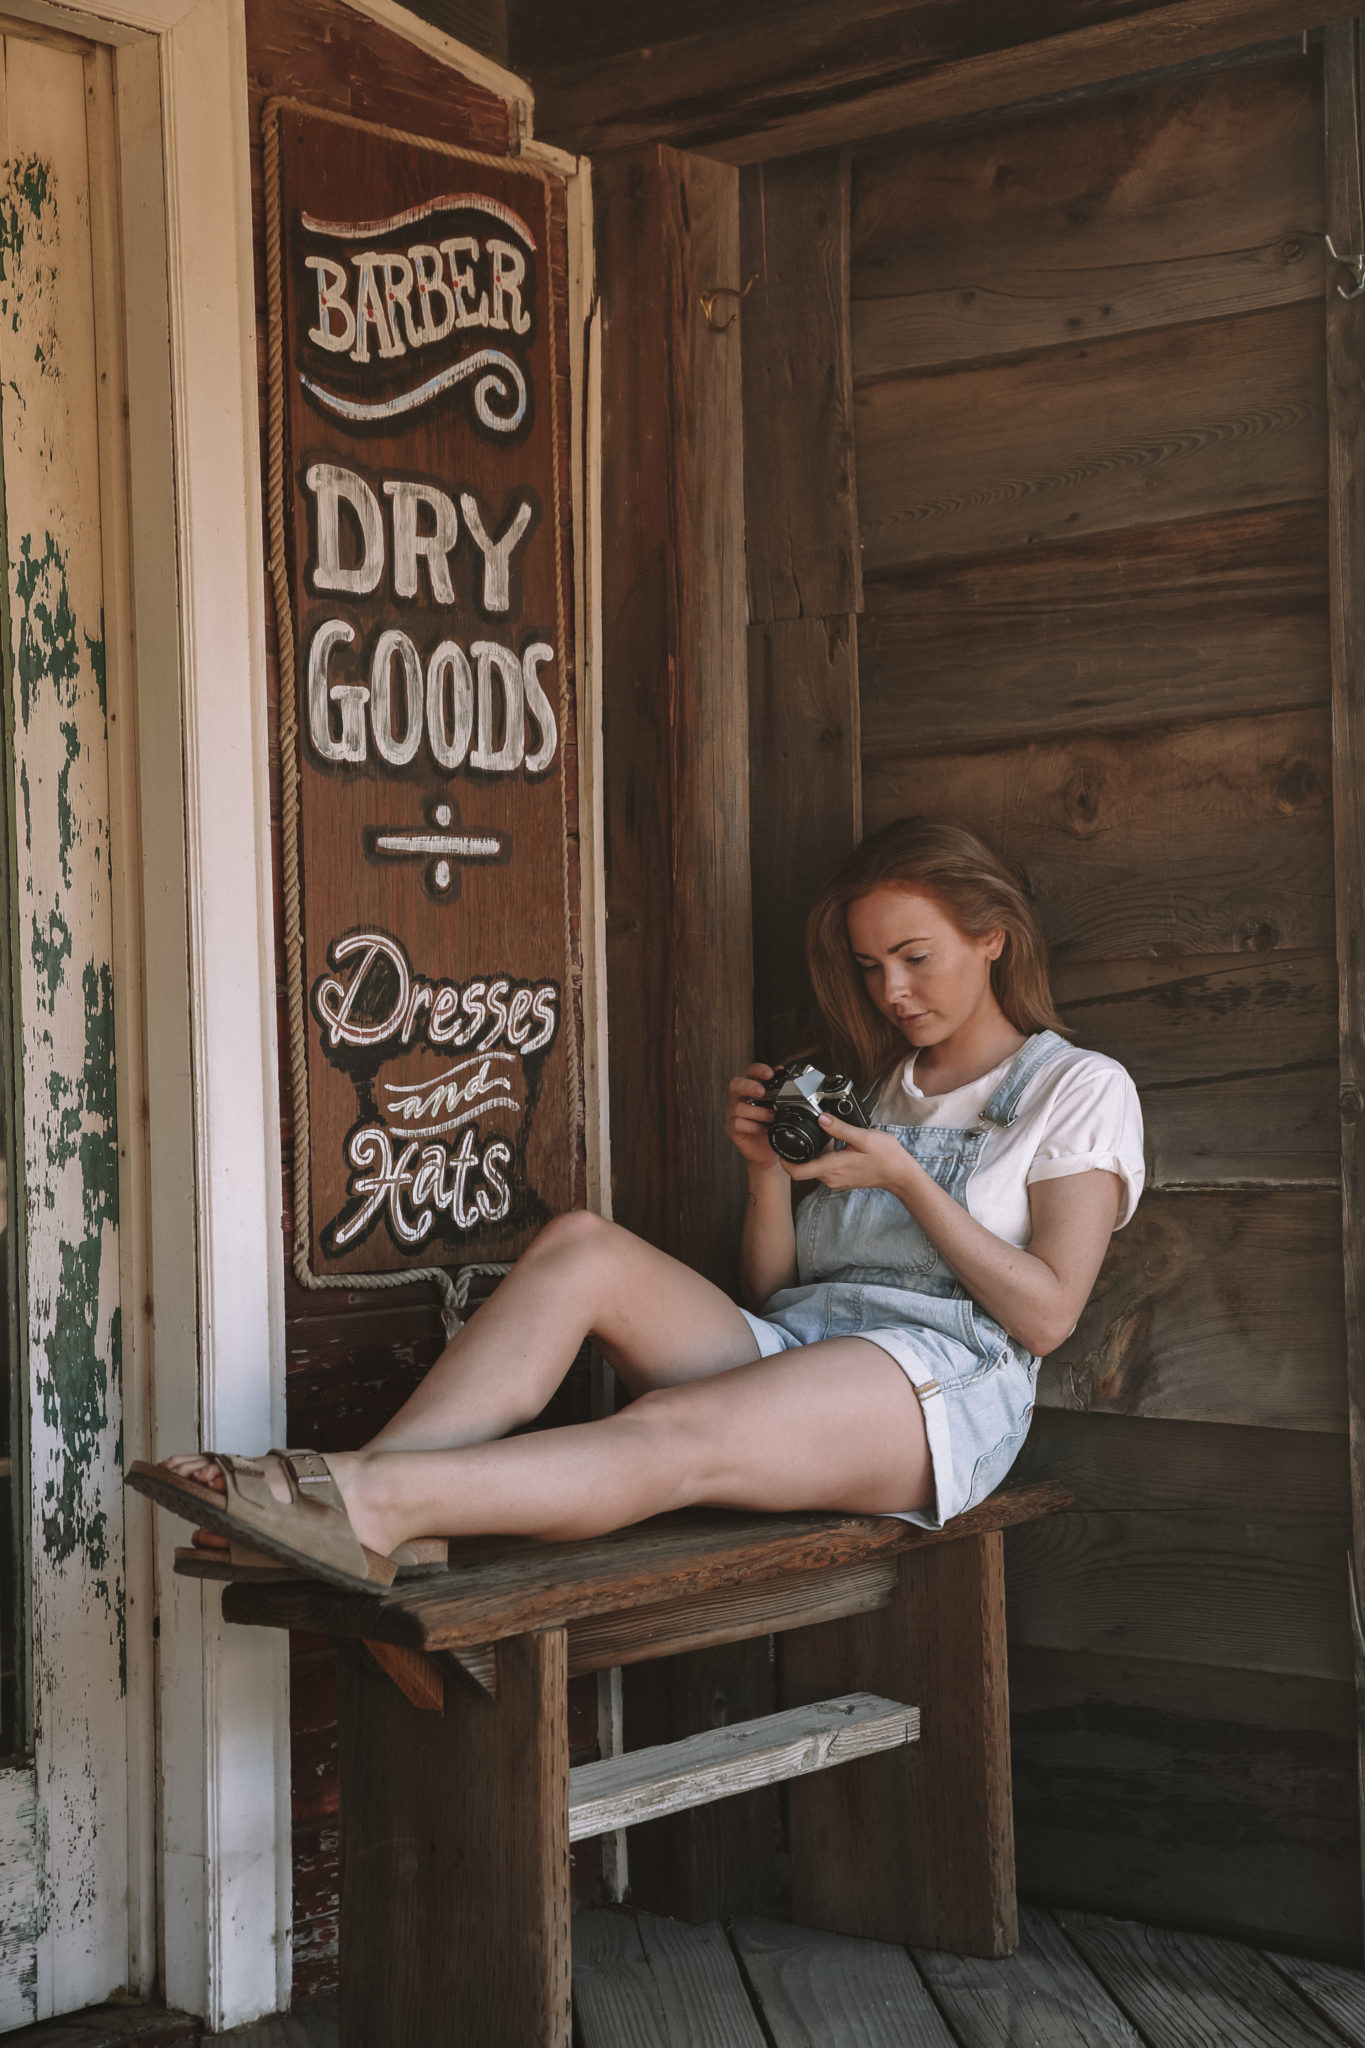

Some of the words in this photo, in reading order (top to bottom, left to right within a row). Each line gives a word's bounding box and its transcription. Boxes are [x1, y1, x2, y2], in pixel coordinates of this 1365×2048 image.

[305, 238, 531, 362] BARBER
[306, 464, 532, 611] DRY
[308, 620, 558, 772] GOODS
[318, 934, 557, 1055] Dresses
[388, 1060, 511, 1120] and
[335, 1129, 511, 1243] Hats
